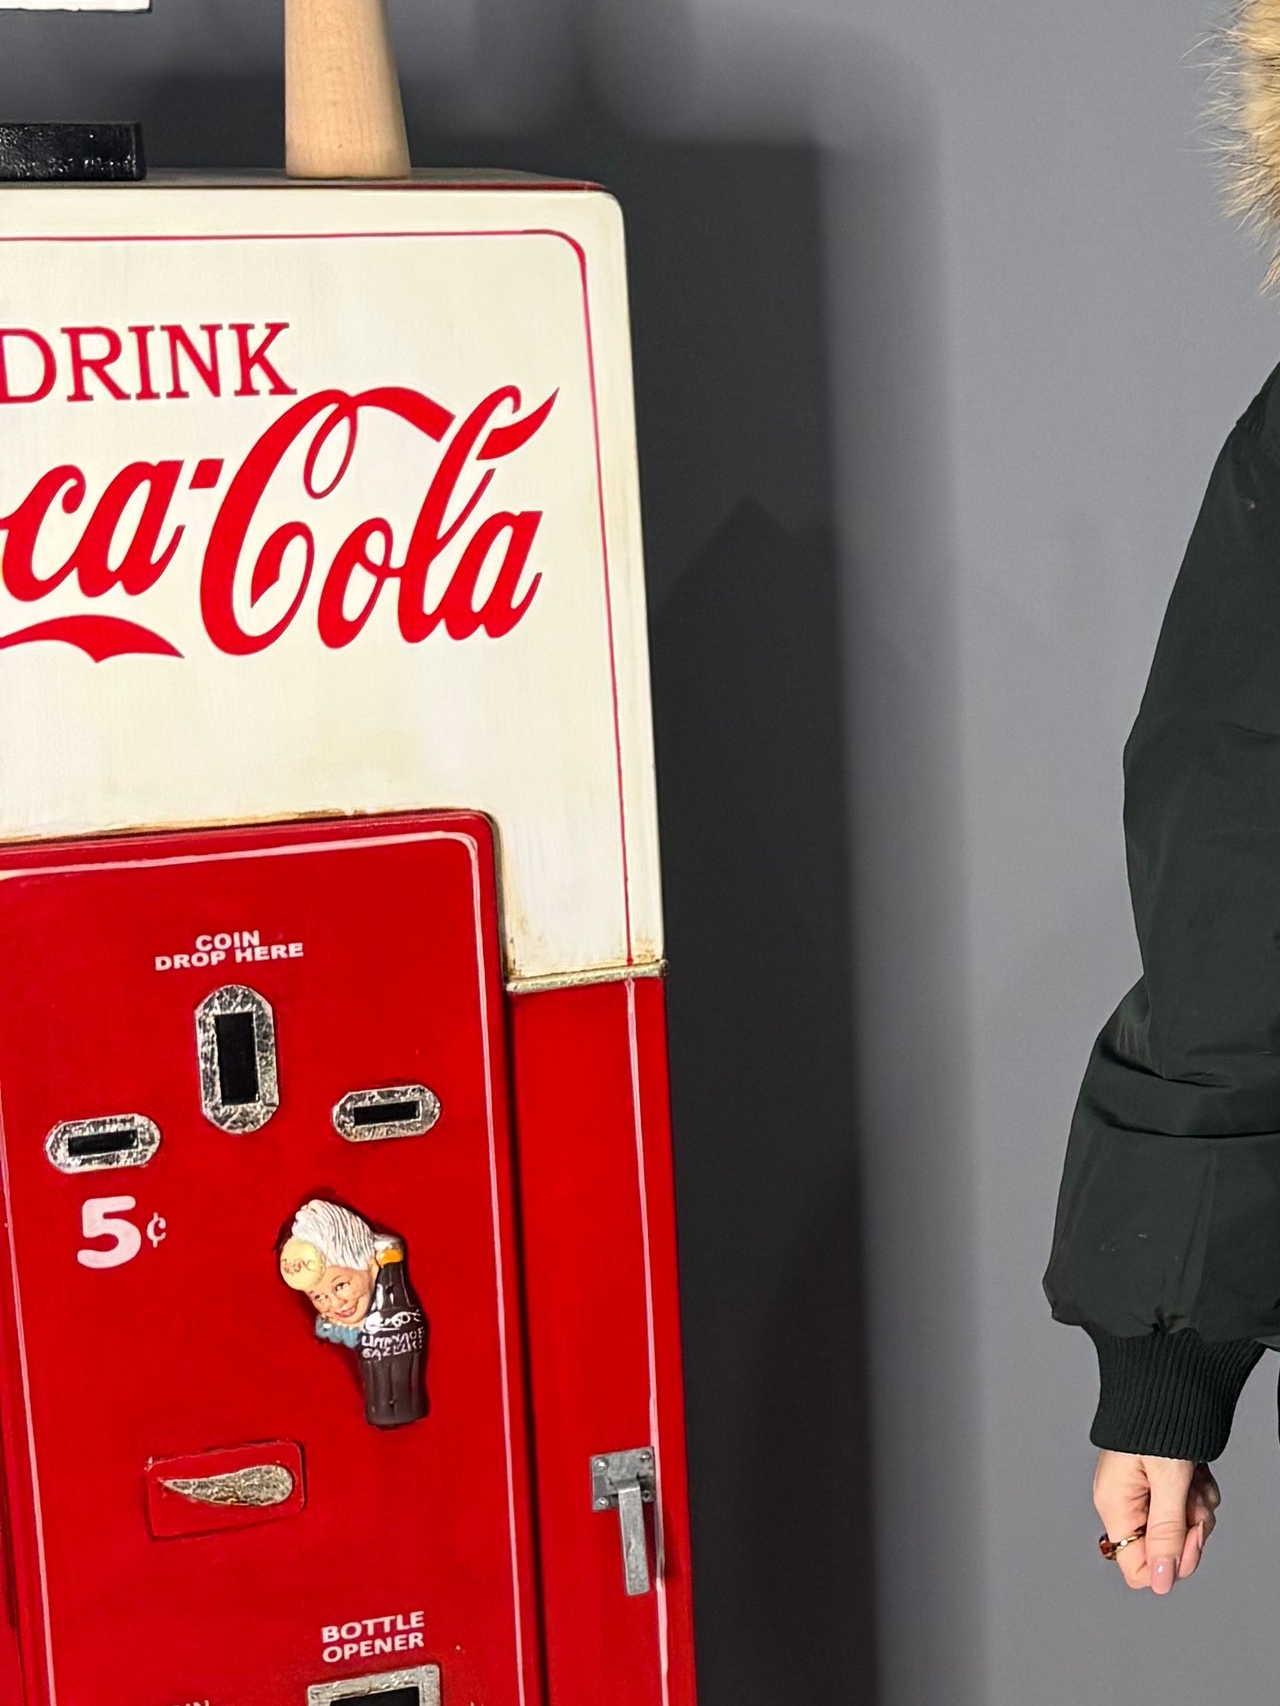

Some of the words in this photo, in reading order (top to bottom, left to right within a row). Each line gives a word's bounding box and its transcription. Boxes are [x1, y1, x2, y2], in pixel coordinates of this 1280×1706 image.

[0, 322, 297, 404] DRINK
[154, 950, 226, 971] DROP
[234, 942, 304, 963] HERE
[195, 930, 260, 952] COIN
[321, 1610, 425, 1643] BOTTLE
[322, 1632, 424, 1663] OPENER
